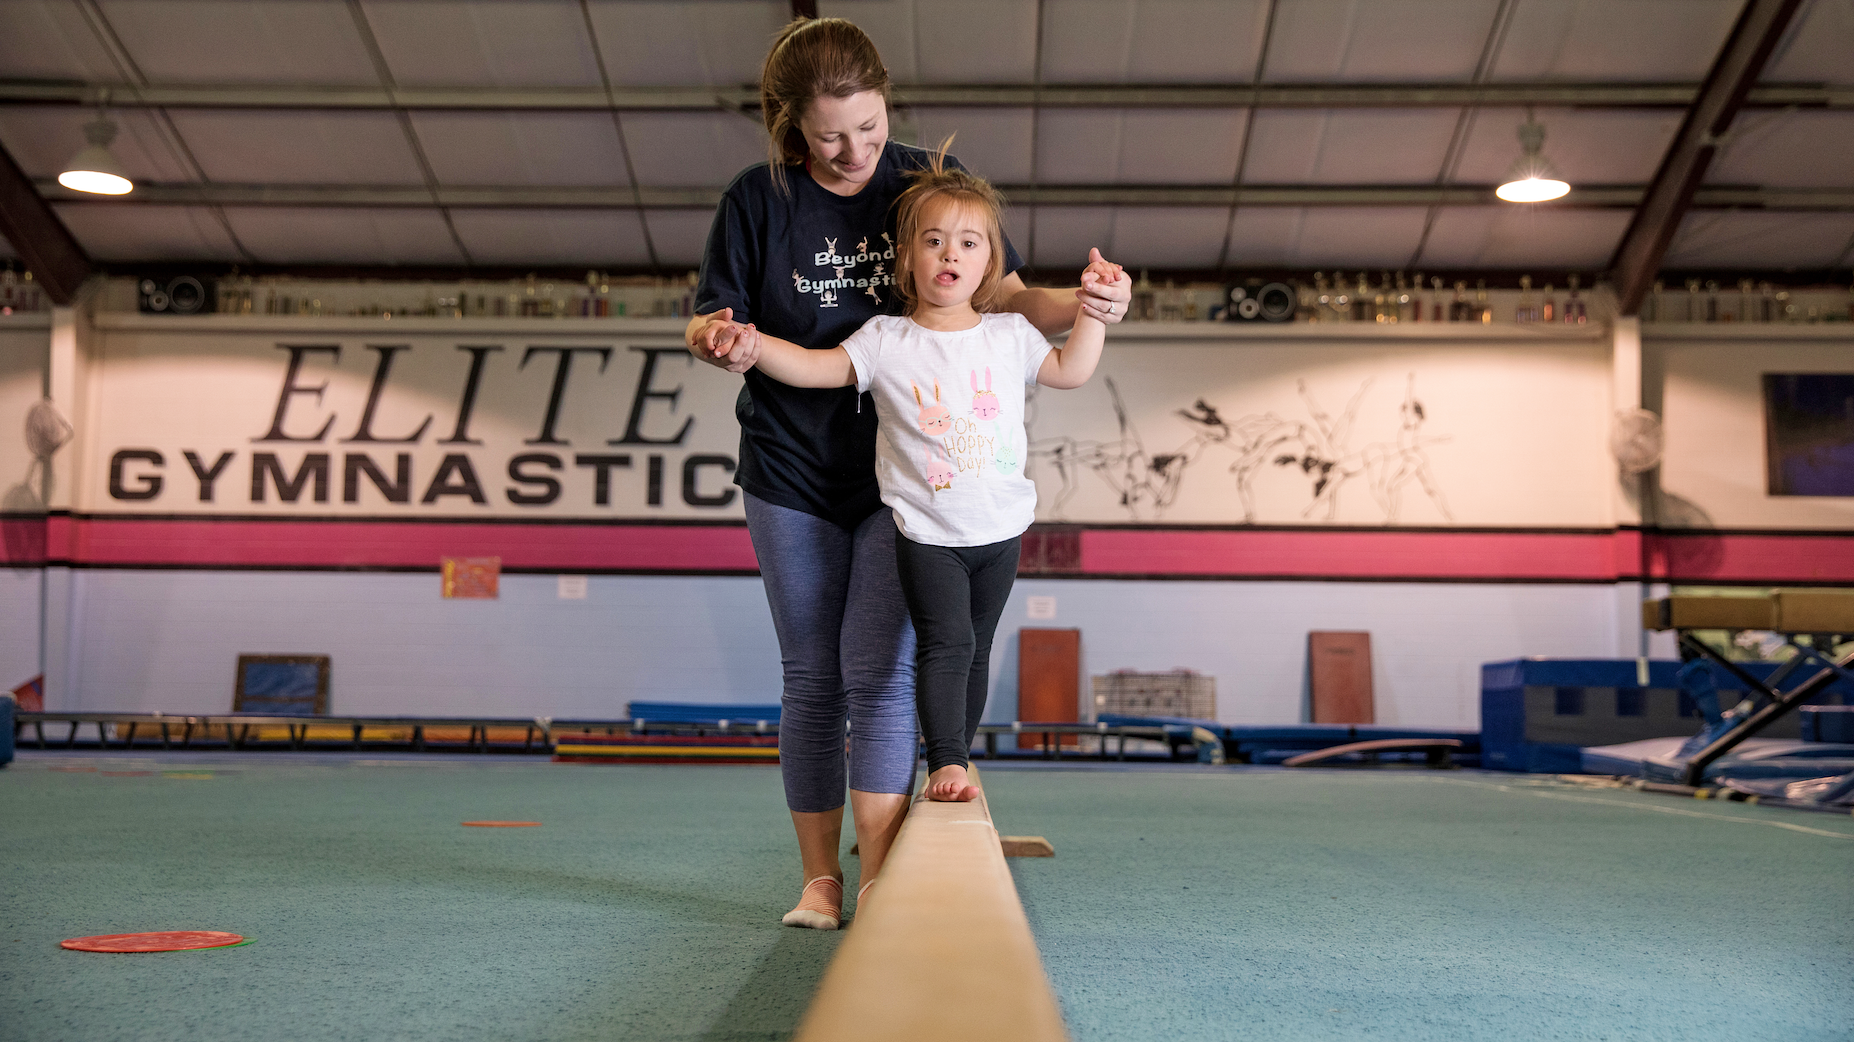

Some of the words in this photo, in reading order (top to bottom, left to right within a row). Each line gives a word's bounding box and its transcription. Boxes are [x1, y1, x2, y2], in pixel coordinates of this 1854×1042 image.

[814, 246, 895, 268] Beyond
[248, 343, 695, 445] ELITE
[954, 417, 977, 435] Oh
[943, 434, 995, 457] HOPPY
[956, 456, 986, 478] Day!
